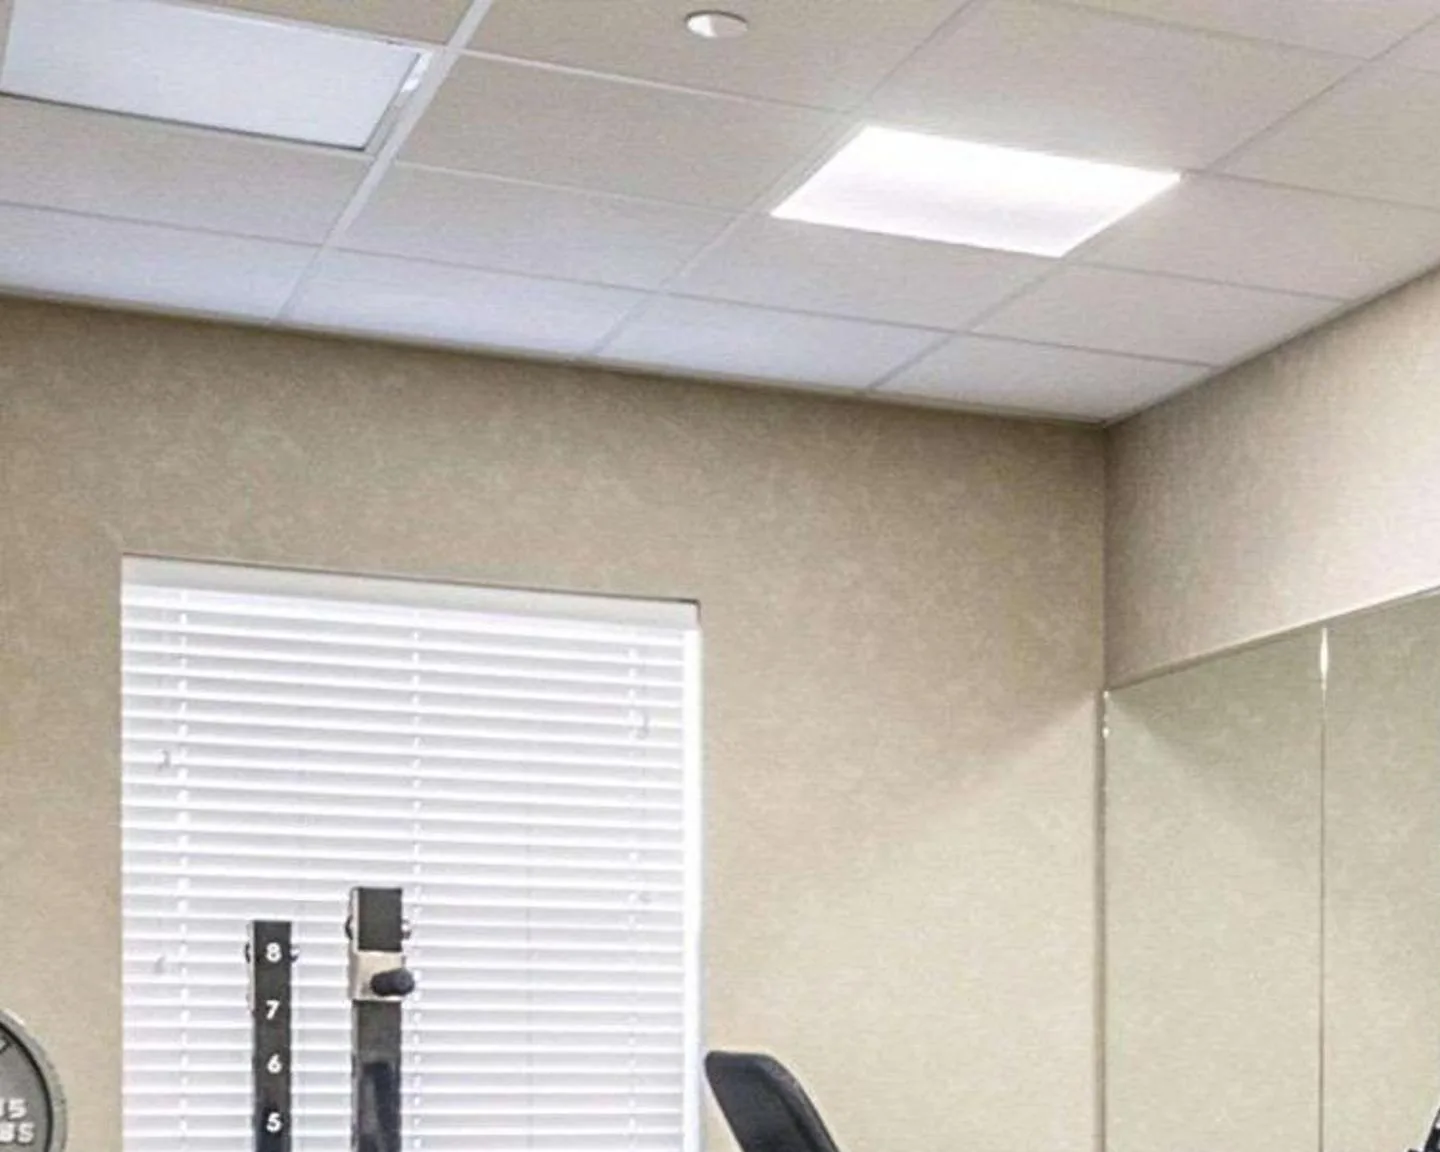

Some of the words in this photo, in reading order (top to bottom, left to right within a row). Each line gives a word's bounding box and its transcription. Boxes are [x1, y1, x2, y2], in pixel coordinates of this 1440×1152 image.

[265, 942, 282, 963] 8
[266, 999, 280, 1020] 7
[267, 1053, 283, 1074] 6
[0, 1098, 27, 1120] 5
[266, 1112, 282, 1133] 5
